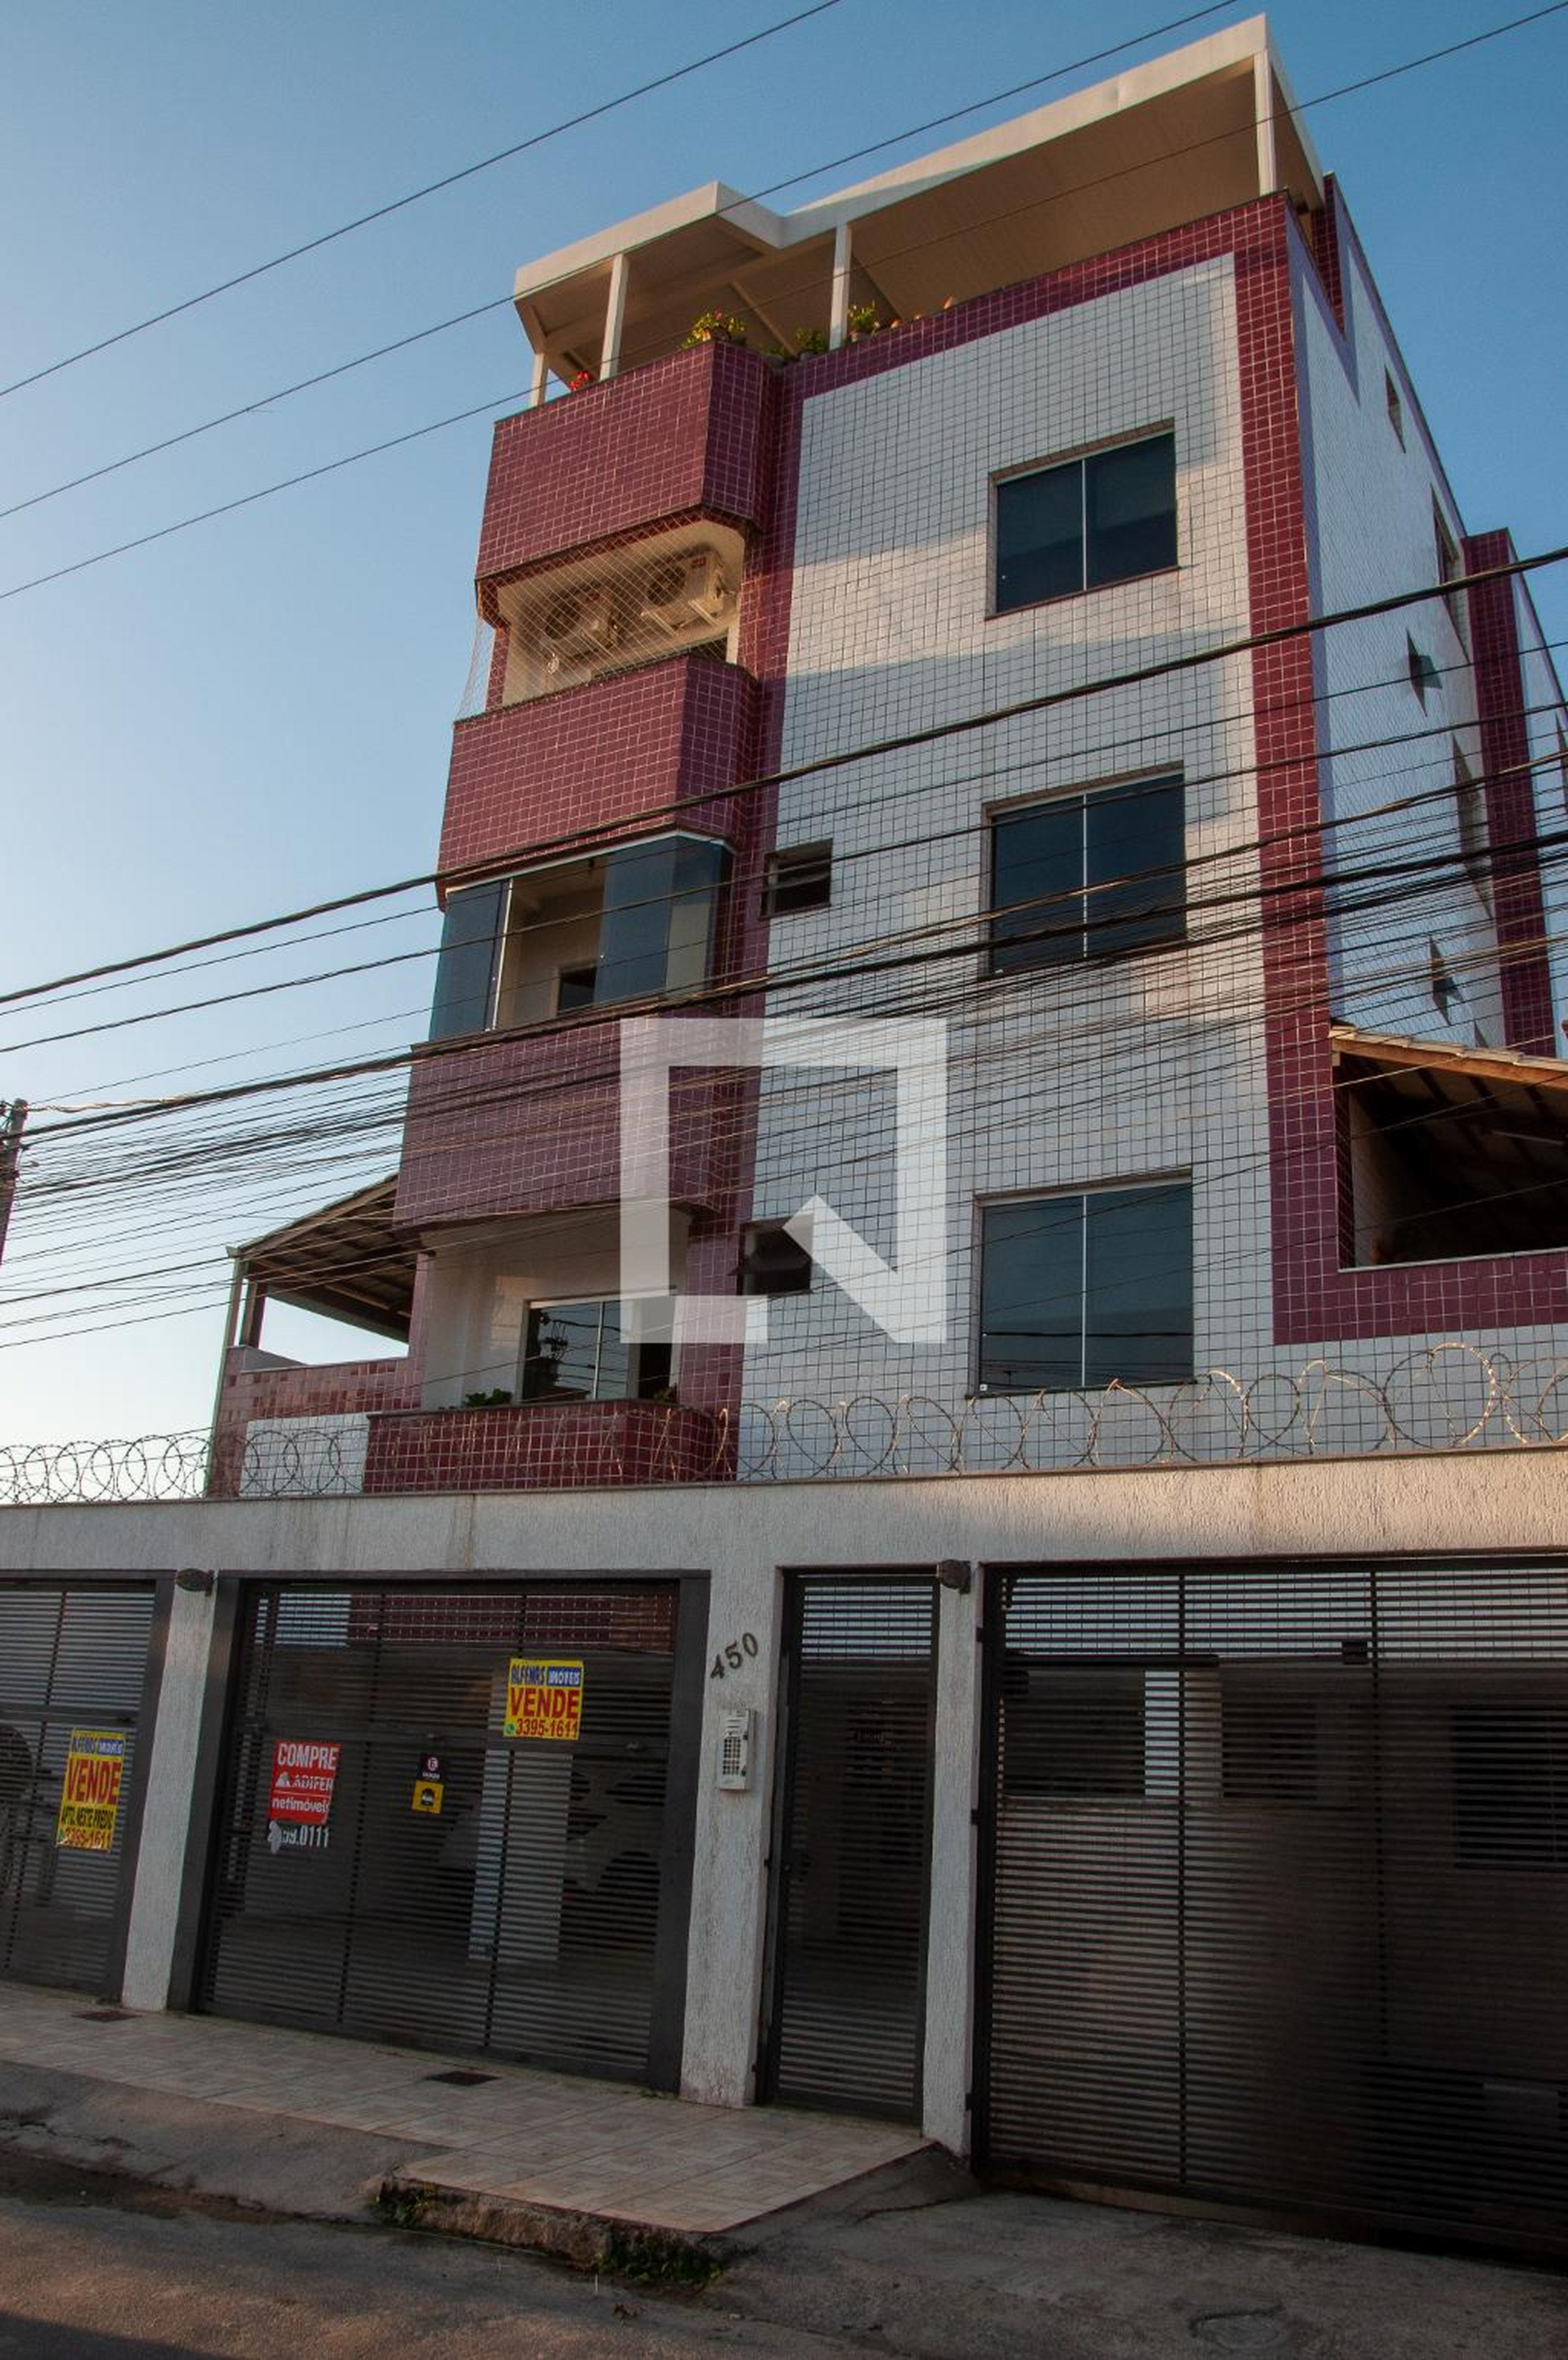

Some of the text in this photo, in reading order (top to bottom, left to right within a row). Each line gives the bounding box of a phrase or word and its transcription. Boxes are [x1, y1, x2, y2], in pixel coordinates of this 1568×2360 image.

[710, 1632, 759, 1679] 450
[511, 1687, 580, 1718] VENDE
[516, 1718, 578, 1738] 3395-1611
[278, 1743, 339, 1769] COMPRE
[67, 1758, 122, 1804] VENDE
